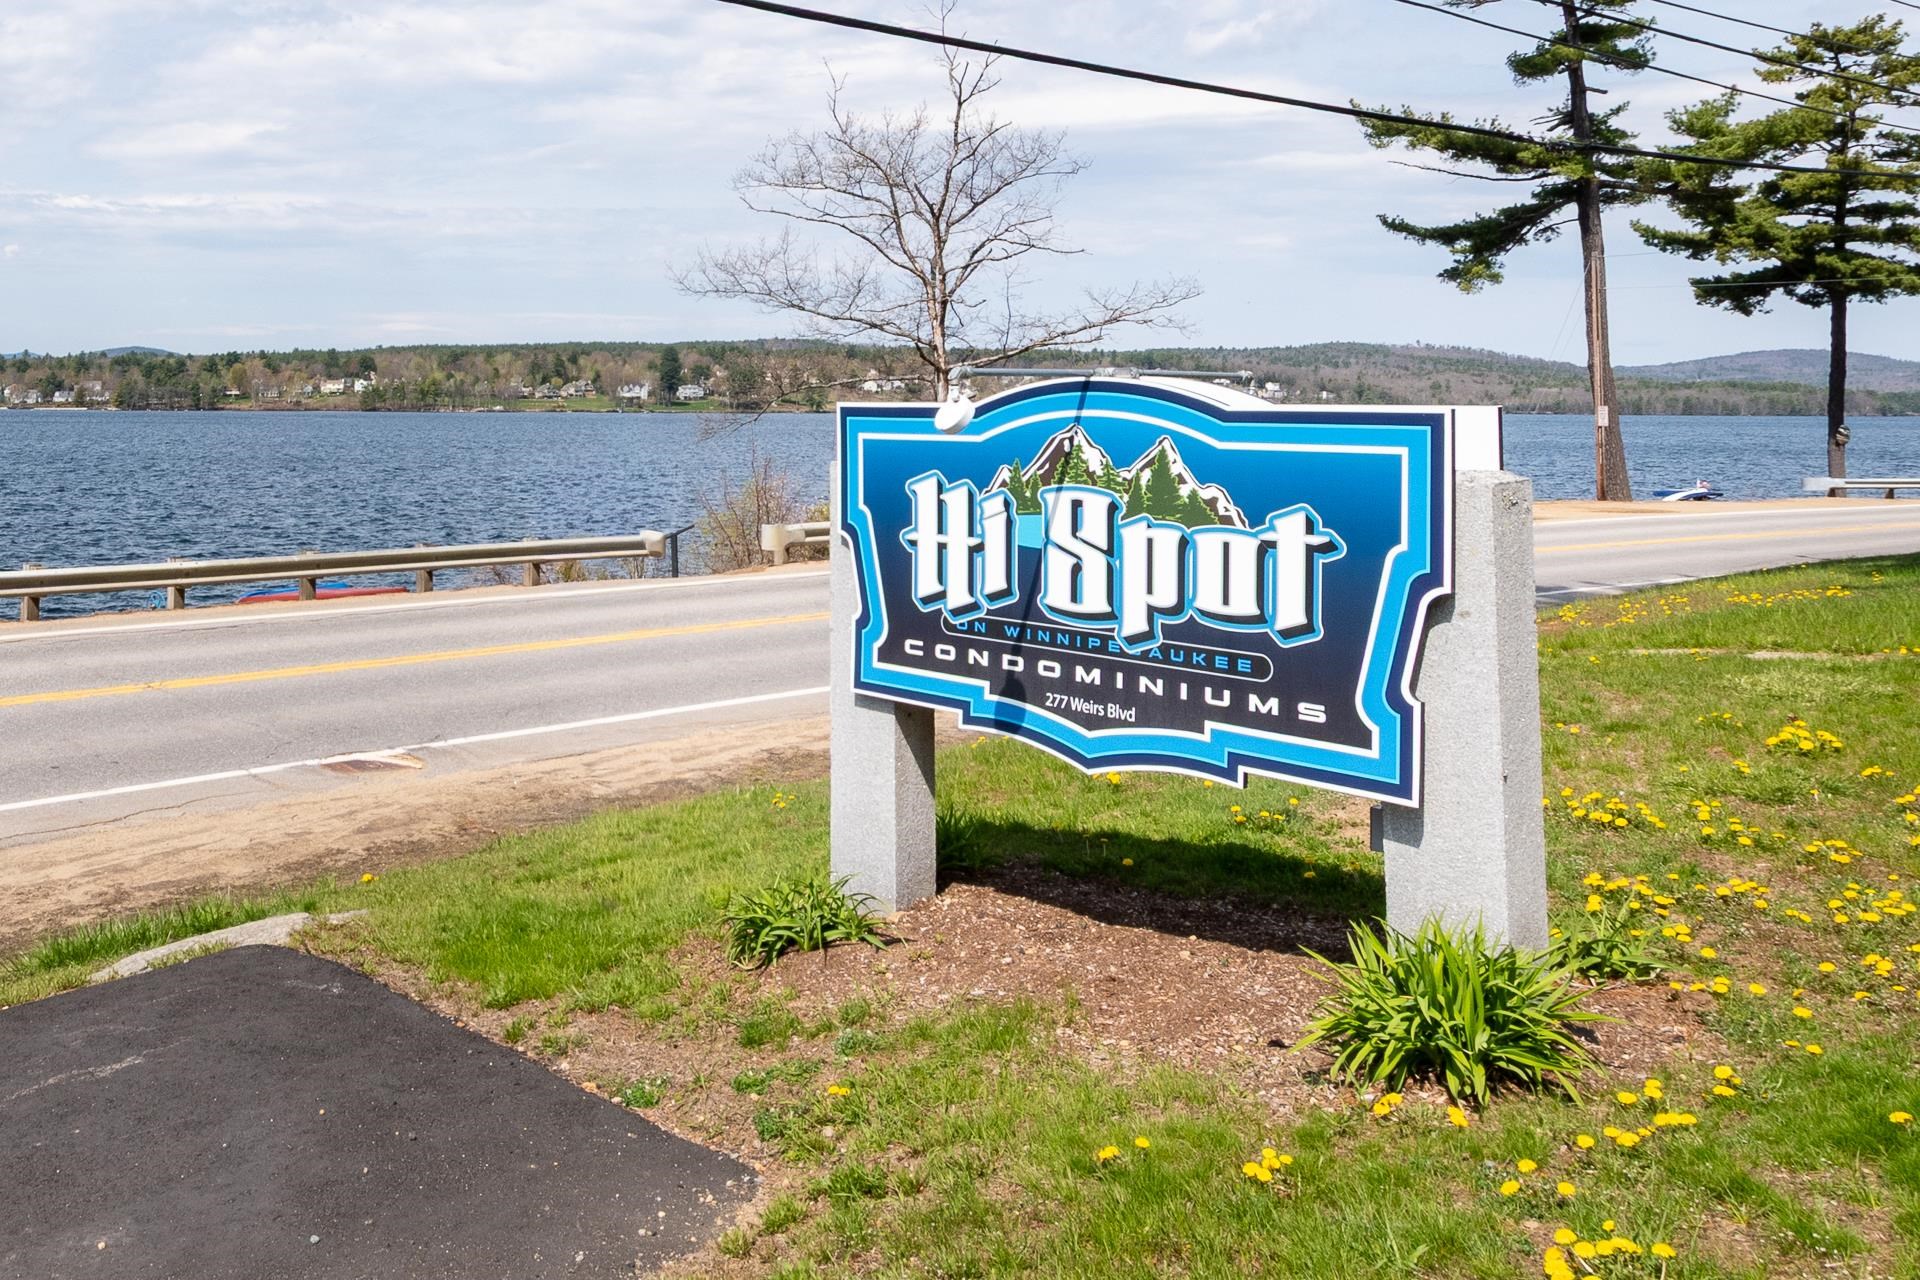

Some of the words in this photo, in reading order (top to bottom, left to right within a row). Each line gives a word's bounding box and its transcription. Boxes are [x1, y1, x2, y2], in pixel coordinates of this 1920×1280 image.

[901, 470, 1019, 622] Hi
[1038, 484, 1347, 652] Spot
[956, 620, 987, 634] ON
[1004, 624, 1253, 673] WINNIPEAUKEE
[904, 639, 1327, 724] CONDOMINIUMS
[1045, 692, 1069, 709] 277
[1070, 696, 1105, 716] Weirs
[1107, 703, 1136, 722] Blvd
